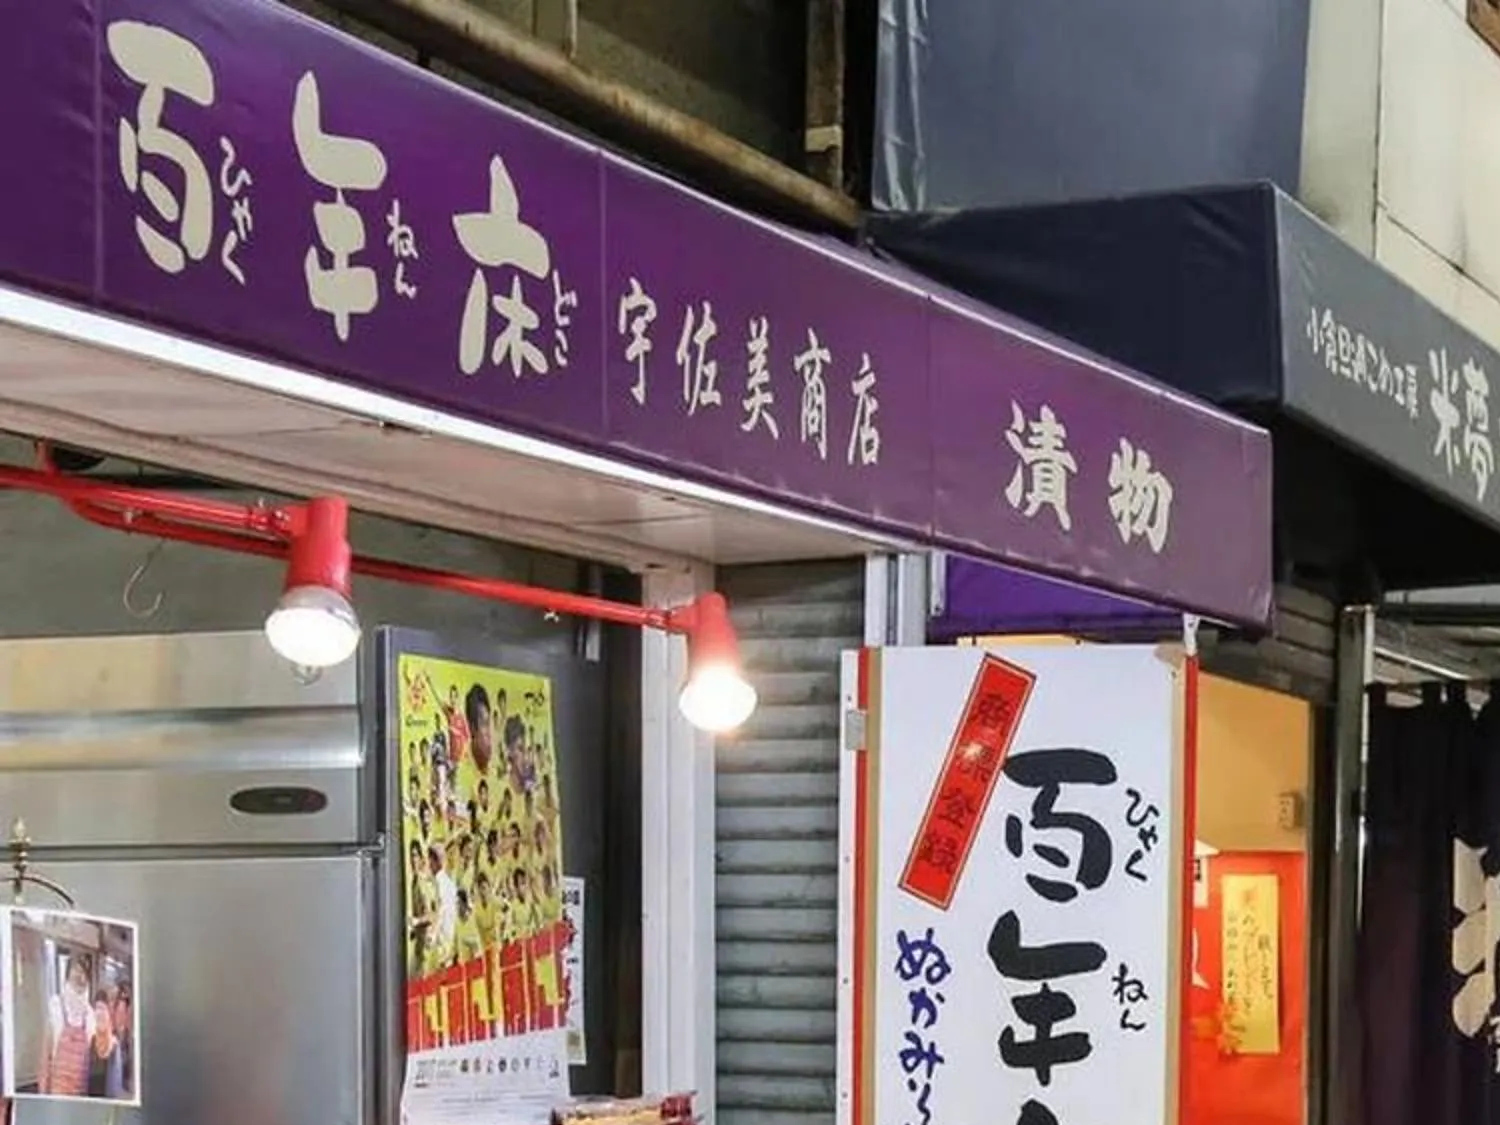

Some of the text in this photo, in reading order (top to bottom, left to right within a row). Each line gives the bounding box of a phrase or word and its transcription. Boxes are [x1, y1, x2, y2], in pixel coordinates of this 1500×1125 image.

[106, 20, 550, 377] 百年床
[386, 199, 419, 299] ねん
[617, 277, 880, 467] 宇佐美商店
[1004, 400, 1174, 553] 漬物
[1124, 787, 1160, 882] ひゃく
[1111, 962, 1149, 1032] ねん
